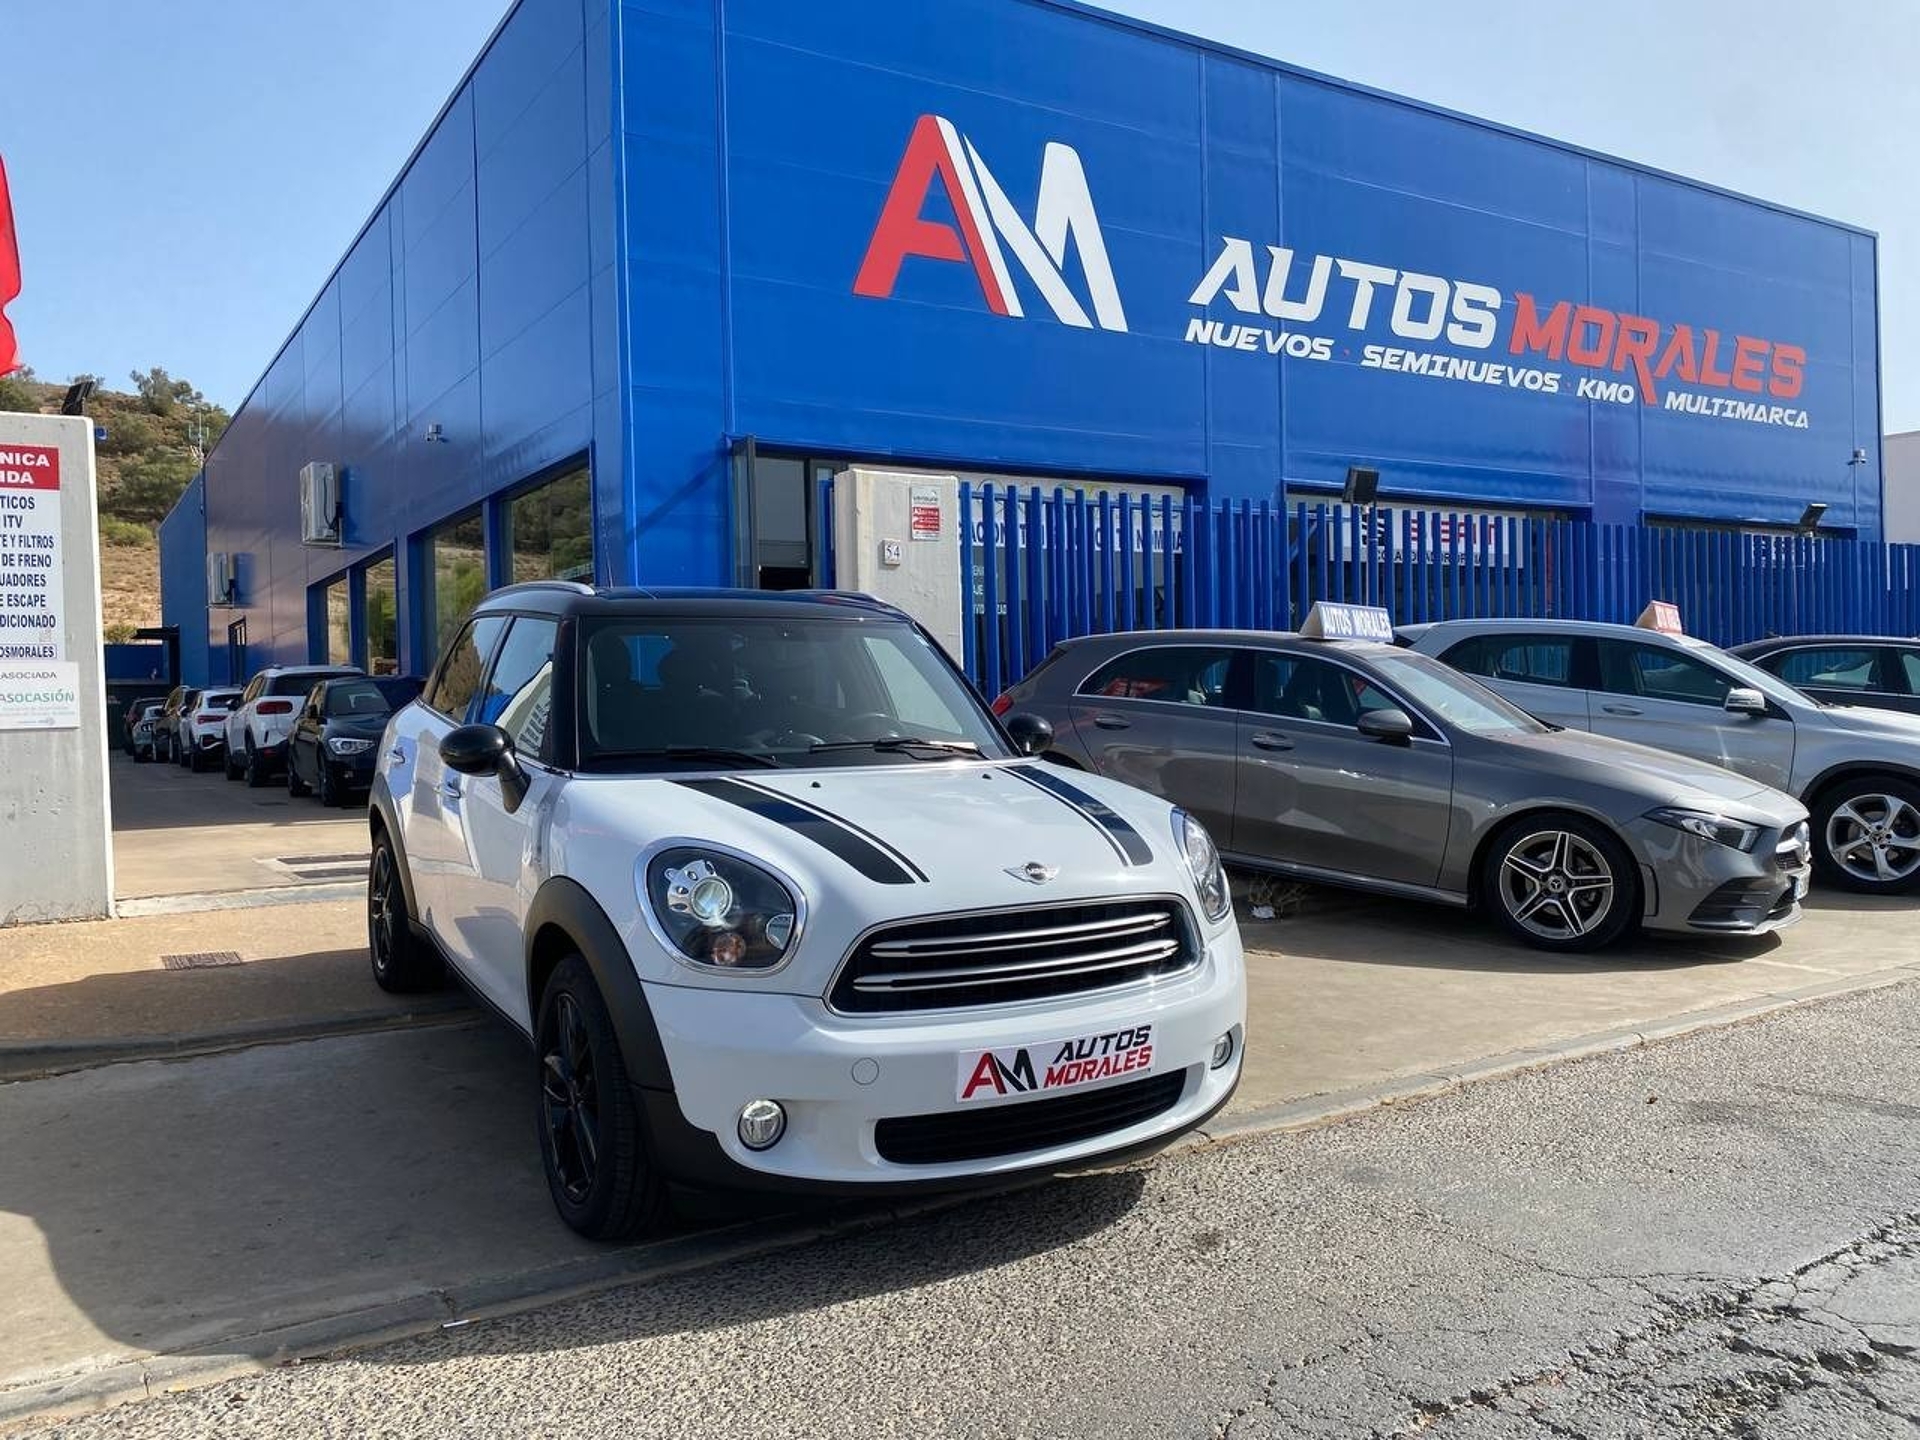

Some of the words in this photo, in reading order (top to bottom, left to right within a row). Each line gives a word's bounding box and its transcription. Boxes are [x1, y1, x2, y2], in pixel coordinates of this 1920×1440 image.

[853, 114, 1129, 333] AM
[1188, 236, 1502, 349] AUTOS
[1509, 292, 1808, 406] MORALES
[1184, 318, 1335, 361] NUEVOS
[1360, 344, 1562, 393] SEMINUEVOS
[1664, 391, 1809, 429] MULTIMARCA
[3, 514, 23, 528] ITV
[10, 534, 16, 548] Y
[18, 535, 54, 549] FILTROS
[2, 553, 15, 566] DE
[18, 554, 52, 568] FRENO
[7, 594, 46, 608] ESCAPE
[1053, 1025, 1152, 1064] AUTOS
[961, 1048, 1039, 1099] AM
[1043, 1045, 1153, 1089] MORALES
